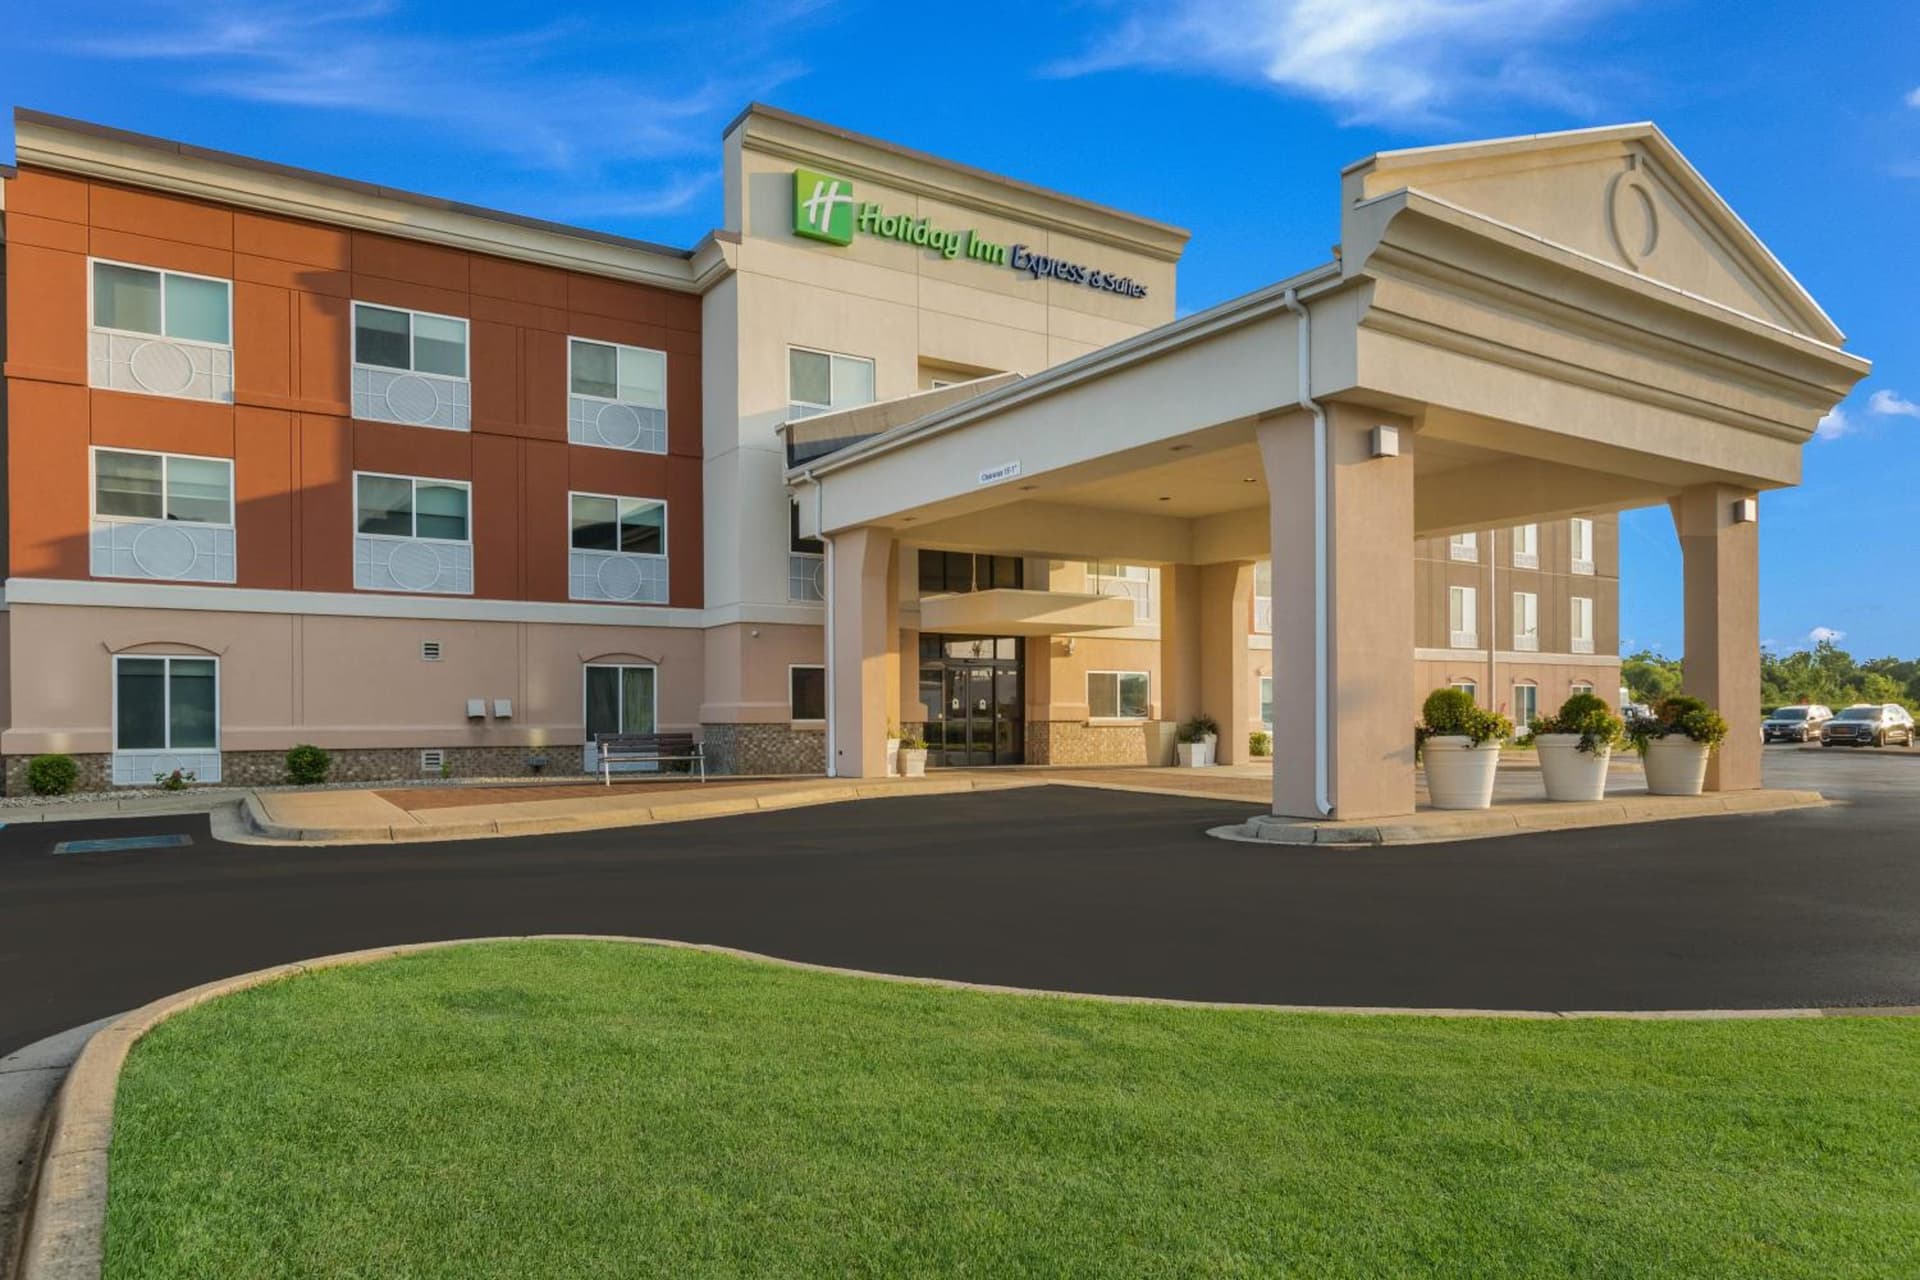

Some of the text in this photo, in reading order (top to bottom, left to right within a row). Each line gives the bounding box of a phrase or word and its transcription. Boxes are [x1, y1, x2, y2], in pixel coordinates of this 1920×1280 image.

[857, 202, 1149, 298] Holiday Inn Express & Suites
